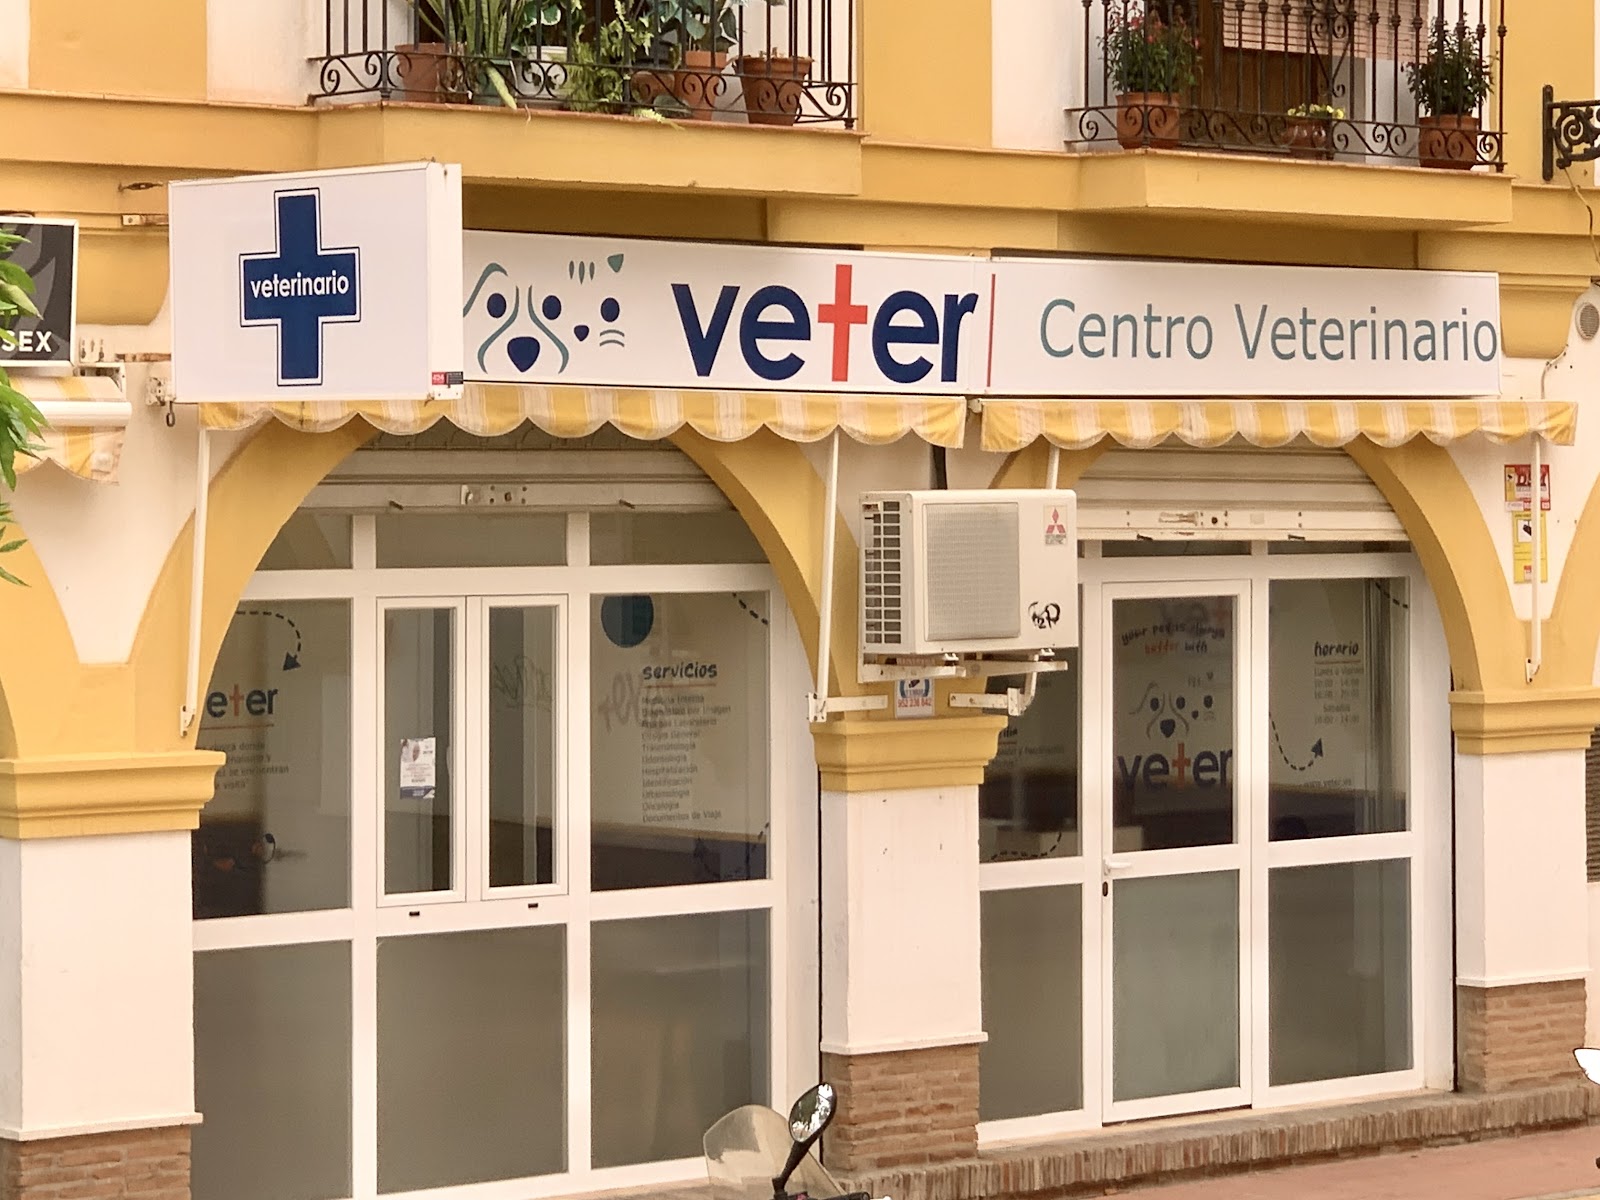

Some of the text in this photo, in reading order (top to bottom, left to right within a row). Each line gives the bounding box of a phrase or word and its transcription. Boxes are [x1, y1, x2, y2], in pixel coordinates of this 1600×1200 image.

[250, 269, 349, 298] veterinario
[671, 264, 979, 384] veter
[1040, 298, 1498, 363] Centro Veterinario
[1314, 641, 1359, 657] horario
[642, 661, 718, 680] servicios
[206, 684, 279, 718] eter
[1117, 742, 1233, 791] veter
